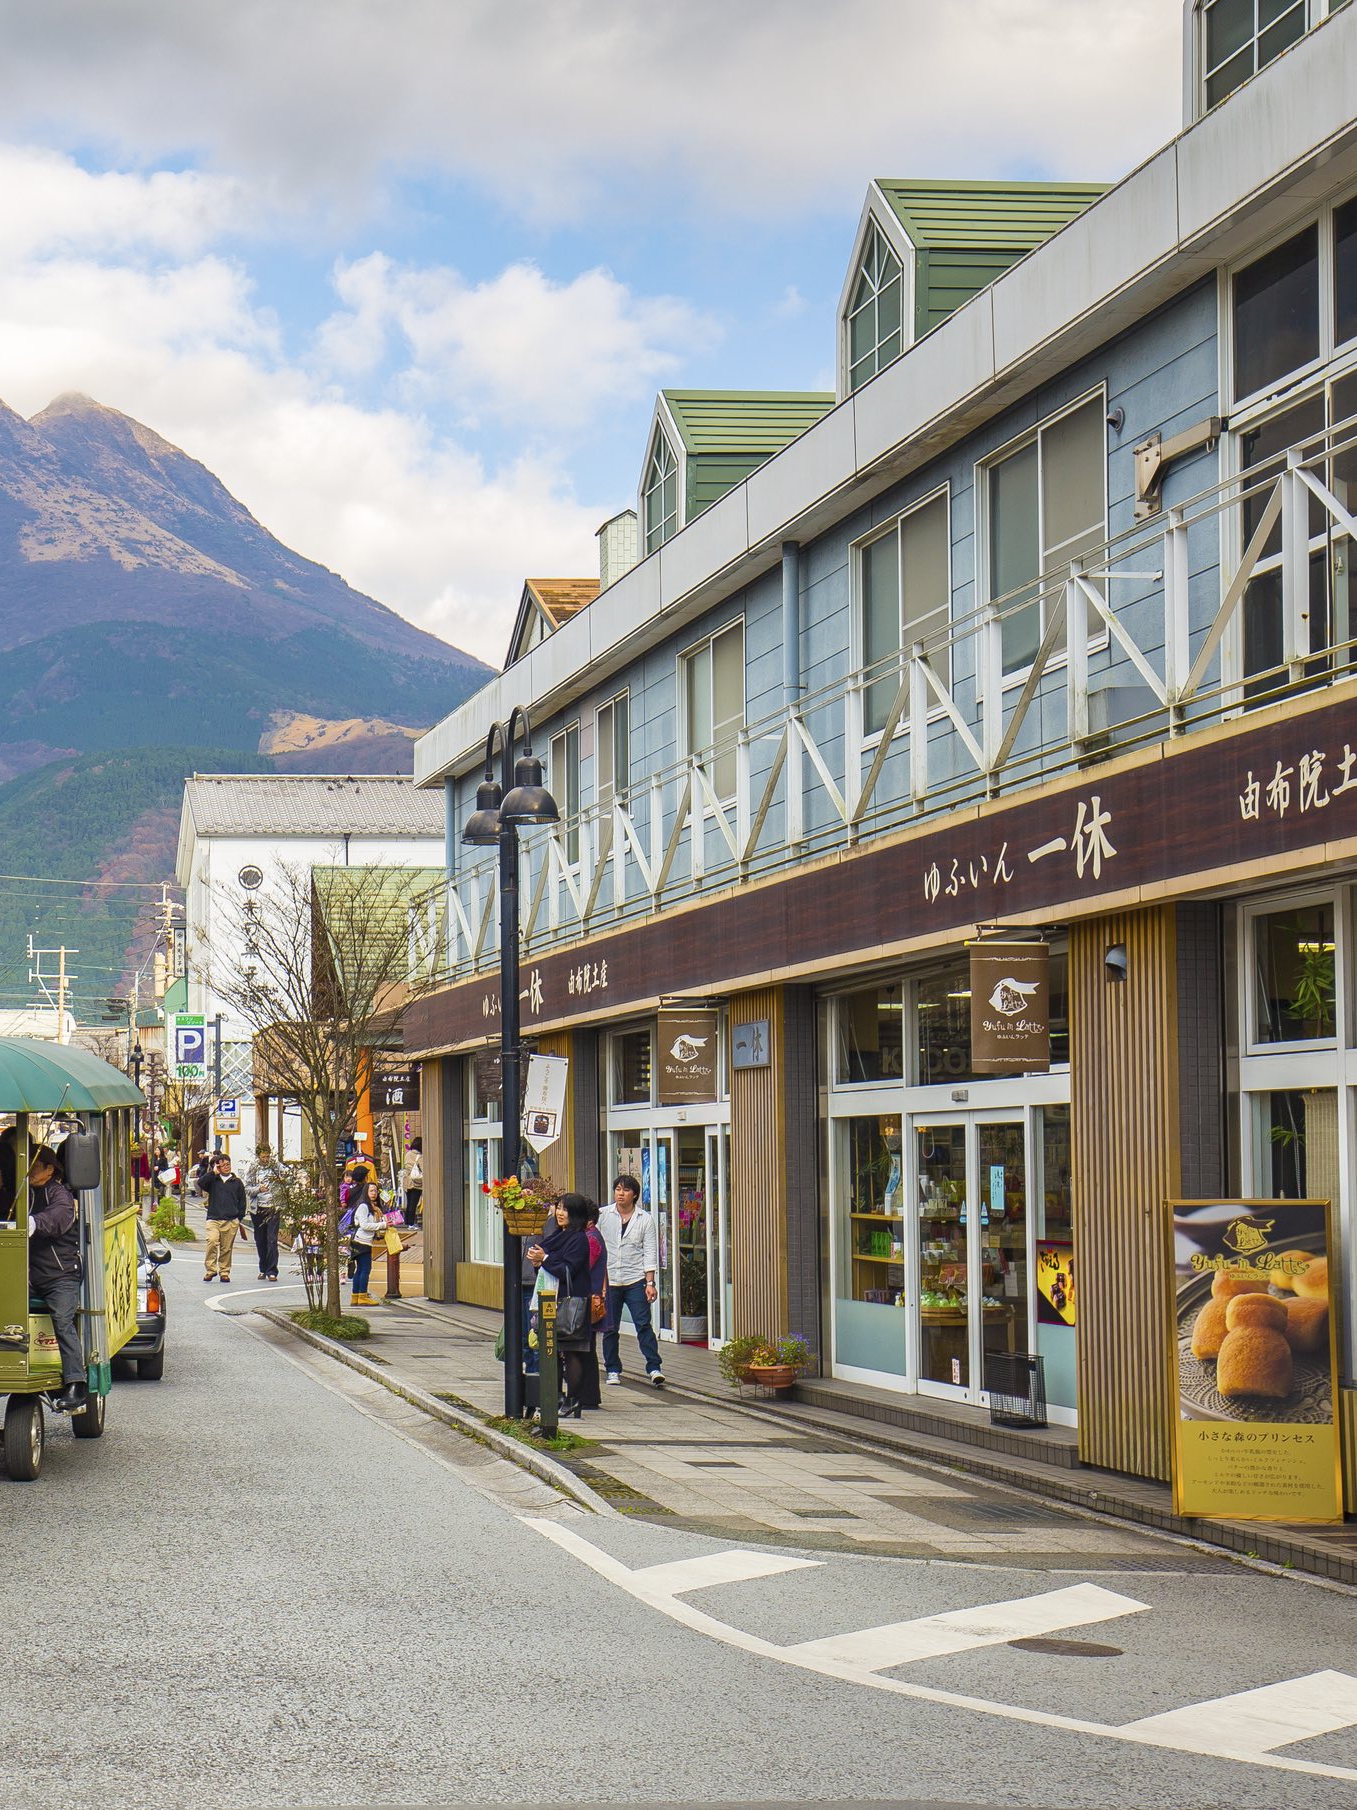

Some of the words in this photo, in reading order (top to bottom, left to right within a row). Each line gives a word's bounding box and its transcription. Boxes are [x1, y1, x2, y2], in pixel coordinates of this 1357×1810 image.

[924, 841, 1014, 904] ゆふいん
[1027, 796, 1117, 880] 一休
[178, 1030, 202, 1061] P
[736, 1026, 763, 1062] 一休
[221, 1101, 234, 1111] P
[1198, 1430, 1315, 1444] 小さな森のプリンセス
